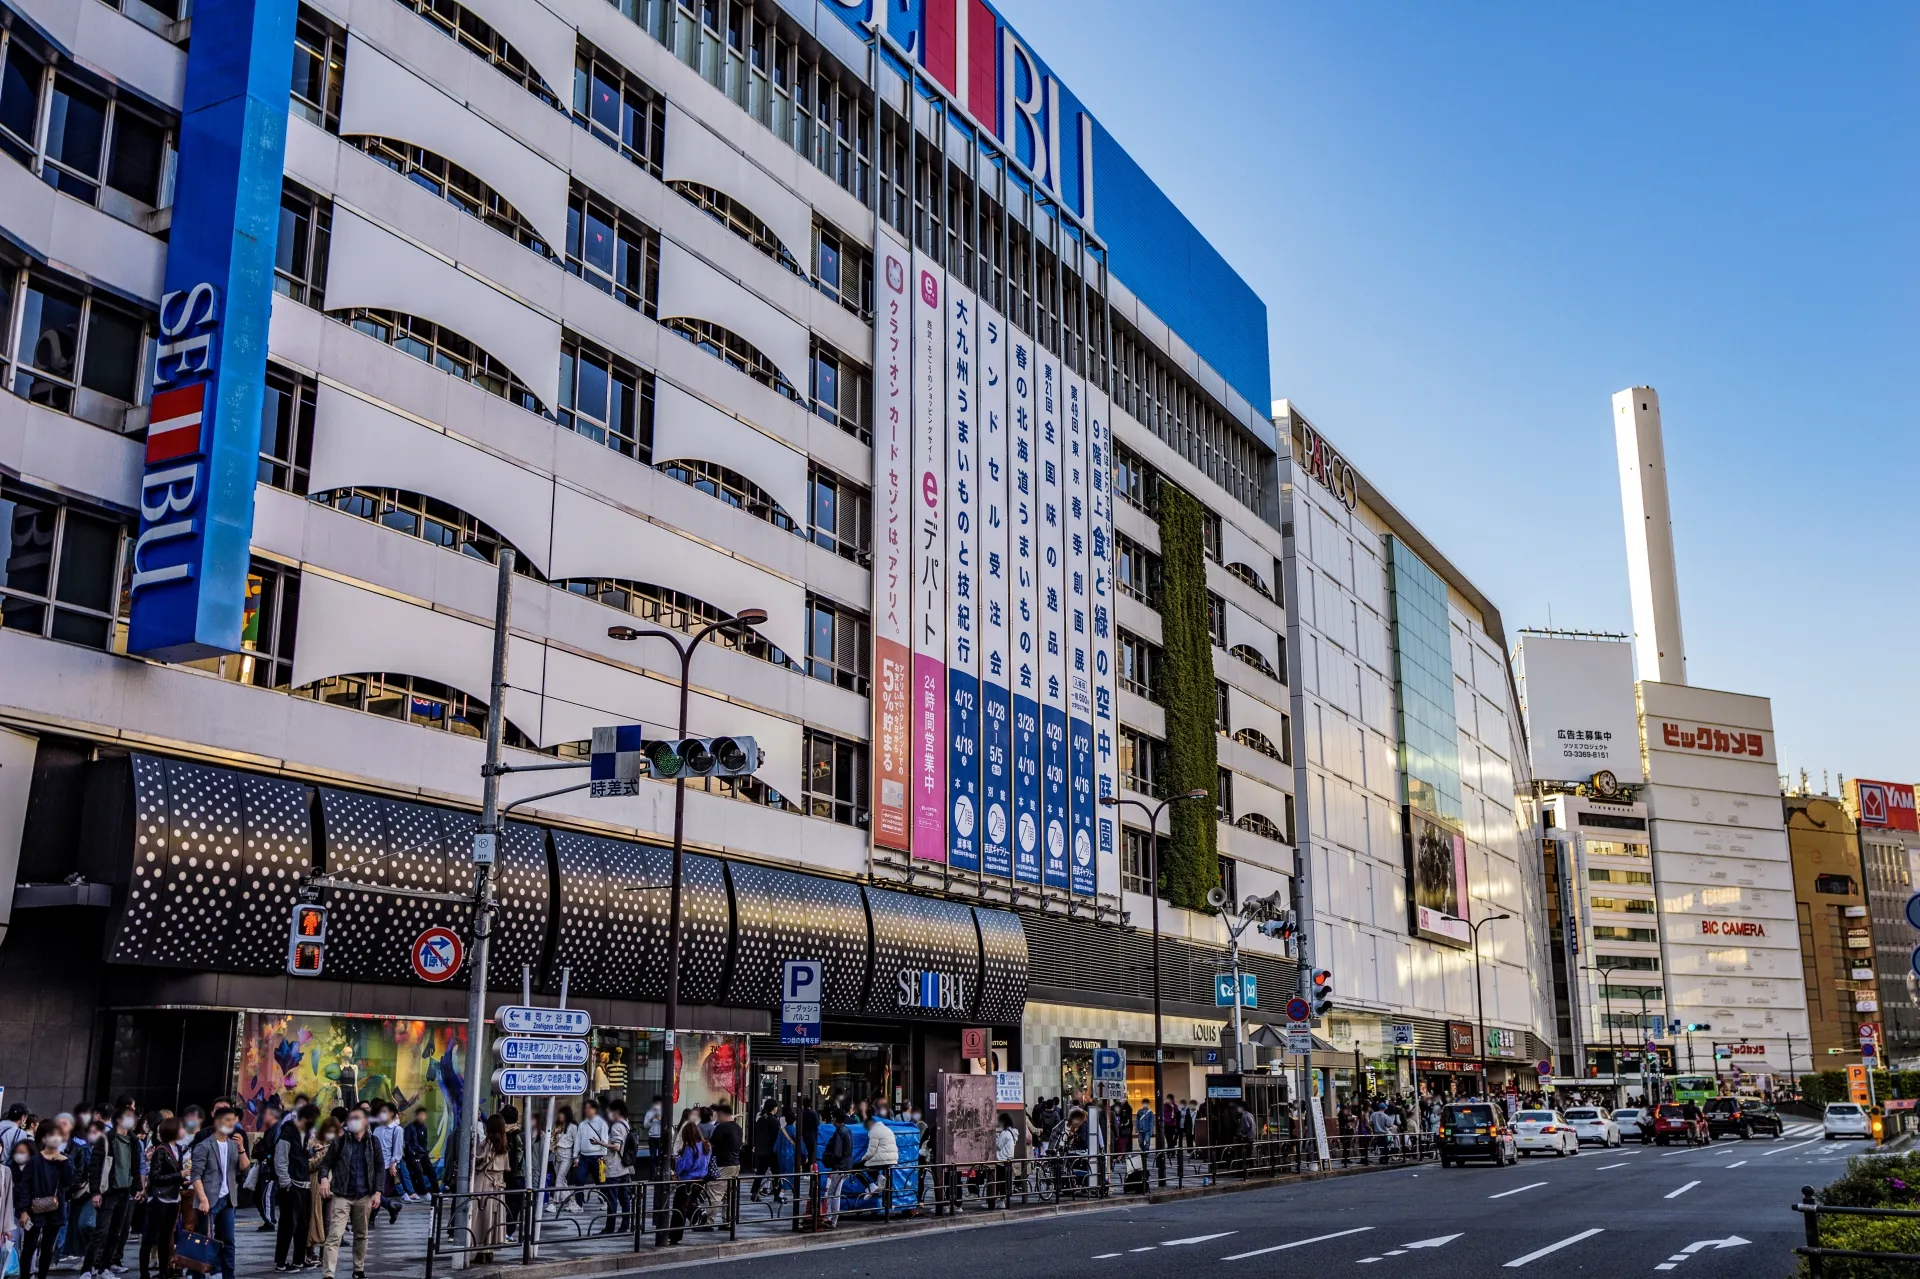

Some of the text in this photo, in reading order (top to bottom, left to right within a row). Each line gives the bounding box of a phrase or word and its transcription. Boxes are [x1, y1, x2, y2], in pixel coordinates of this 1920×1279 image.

[827, 0, 1094, 232] IBU
[131, 281, 220, 598] SEIBU
[888, 405, 900, 462] カード
[1301, 422, 1358, 512] PARCO
[956, 298, 971, 665] 大九州うまいものと技紀行
[987, 321, 1002, 677] ランドセル受注会
[1015, 343, 1032, 689] 春の北海道うまいもの会
[887, 468, 901, 636] セゾンは、アプリへ。
[1044, 421, 1059, 700] 全国味の逸品会
[955, 689, 973, 711] 4/12
[1092, 524, 1113, 856] 食と緑の空中庭園
[883, 658, 894, 772] 5%貯まる
[987, 700, 1005, 721] 4/28
[1018, 713, 1035, 733] 3/28
[1046, 722, 1062, 742] 4/20
[924, 675, 936, 795] 24時間営業中
[955, 735, 973, 756] 4/18
[1073, 735, 1089, 753] 4/12
[1557, 730, 1612, 742] 広告主募集中
[1663, 723, 1764, 756] ビックカメラ
[989, 745, 1003, 765] 5/5
[1018, 755, 1035, 776] 4/10
[1046, 763, 1063, 784] 4/30
[591, 778, 638, 797] 時差式
[954, 778, 974, 794] 本館
[1074, 775, 1089, 795] 4/16
[1883, 785, 1917, 809] YAM
[1701, 920, 1766, 937] BIC CAMERA
[427, 955, 451, 969] 原付
[790, 965, 814, 997] P
[897, 969, 964, 1010] SEIBU
[532, 1022, 574, 1031] Zoshigaya Cemetery
[1192, 1023, 1217, 1041] LOUIS
[1069, 1040, 1101, 1049] LOUIS VUITTON
[1140, 1050, 1155, 1059] LOUIS
[518, 1052, 531, 1060] Tokyo
[1096, 1050, 1120, 1077] P
[1207, 1053, 1217, 1061] 27
[1853, 1069, 1862, 1079] P
